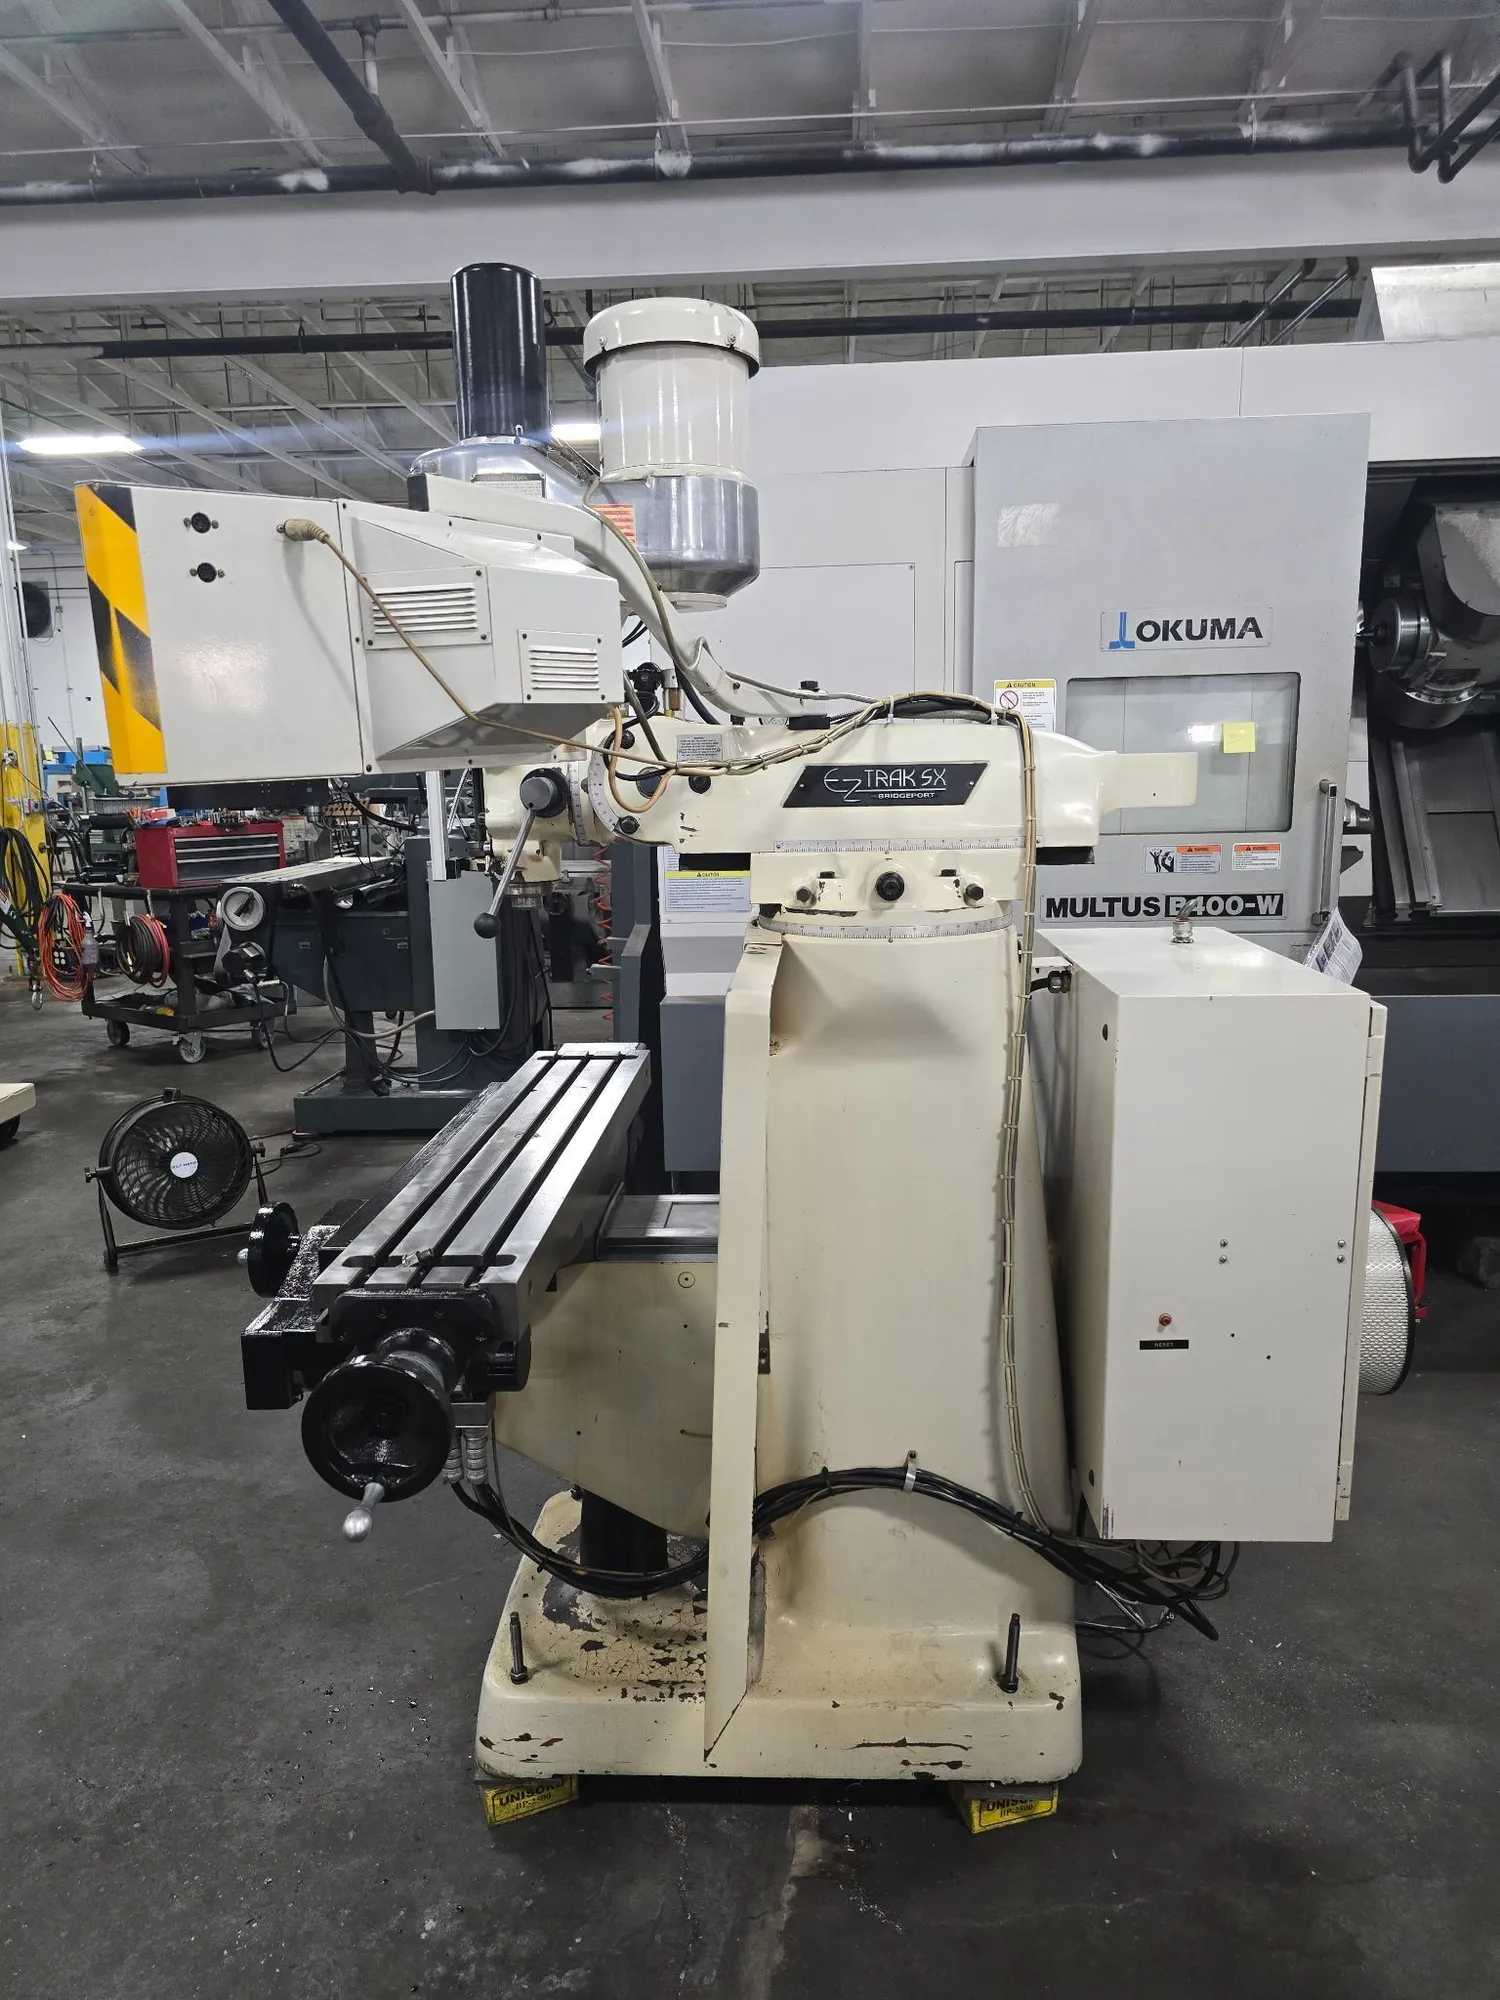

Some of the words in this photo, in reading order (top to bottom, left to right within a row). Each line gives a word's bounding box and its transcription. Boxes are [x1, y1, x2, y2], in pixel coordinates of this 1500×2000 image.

[1135, 616, 1264, 643] OKUMA
[921, 768, 947, 786] SX
[1045, 896, 1161, 918] MULTUS
[1168, 894, 1282, 916] B400-W
